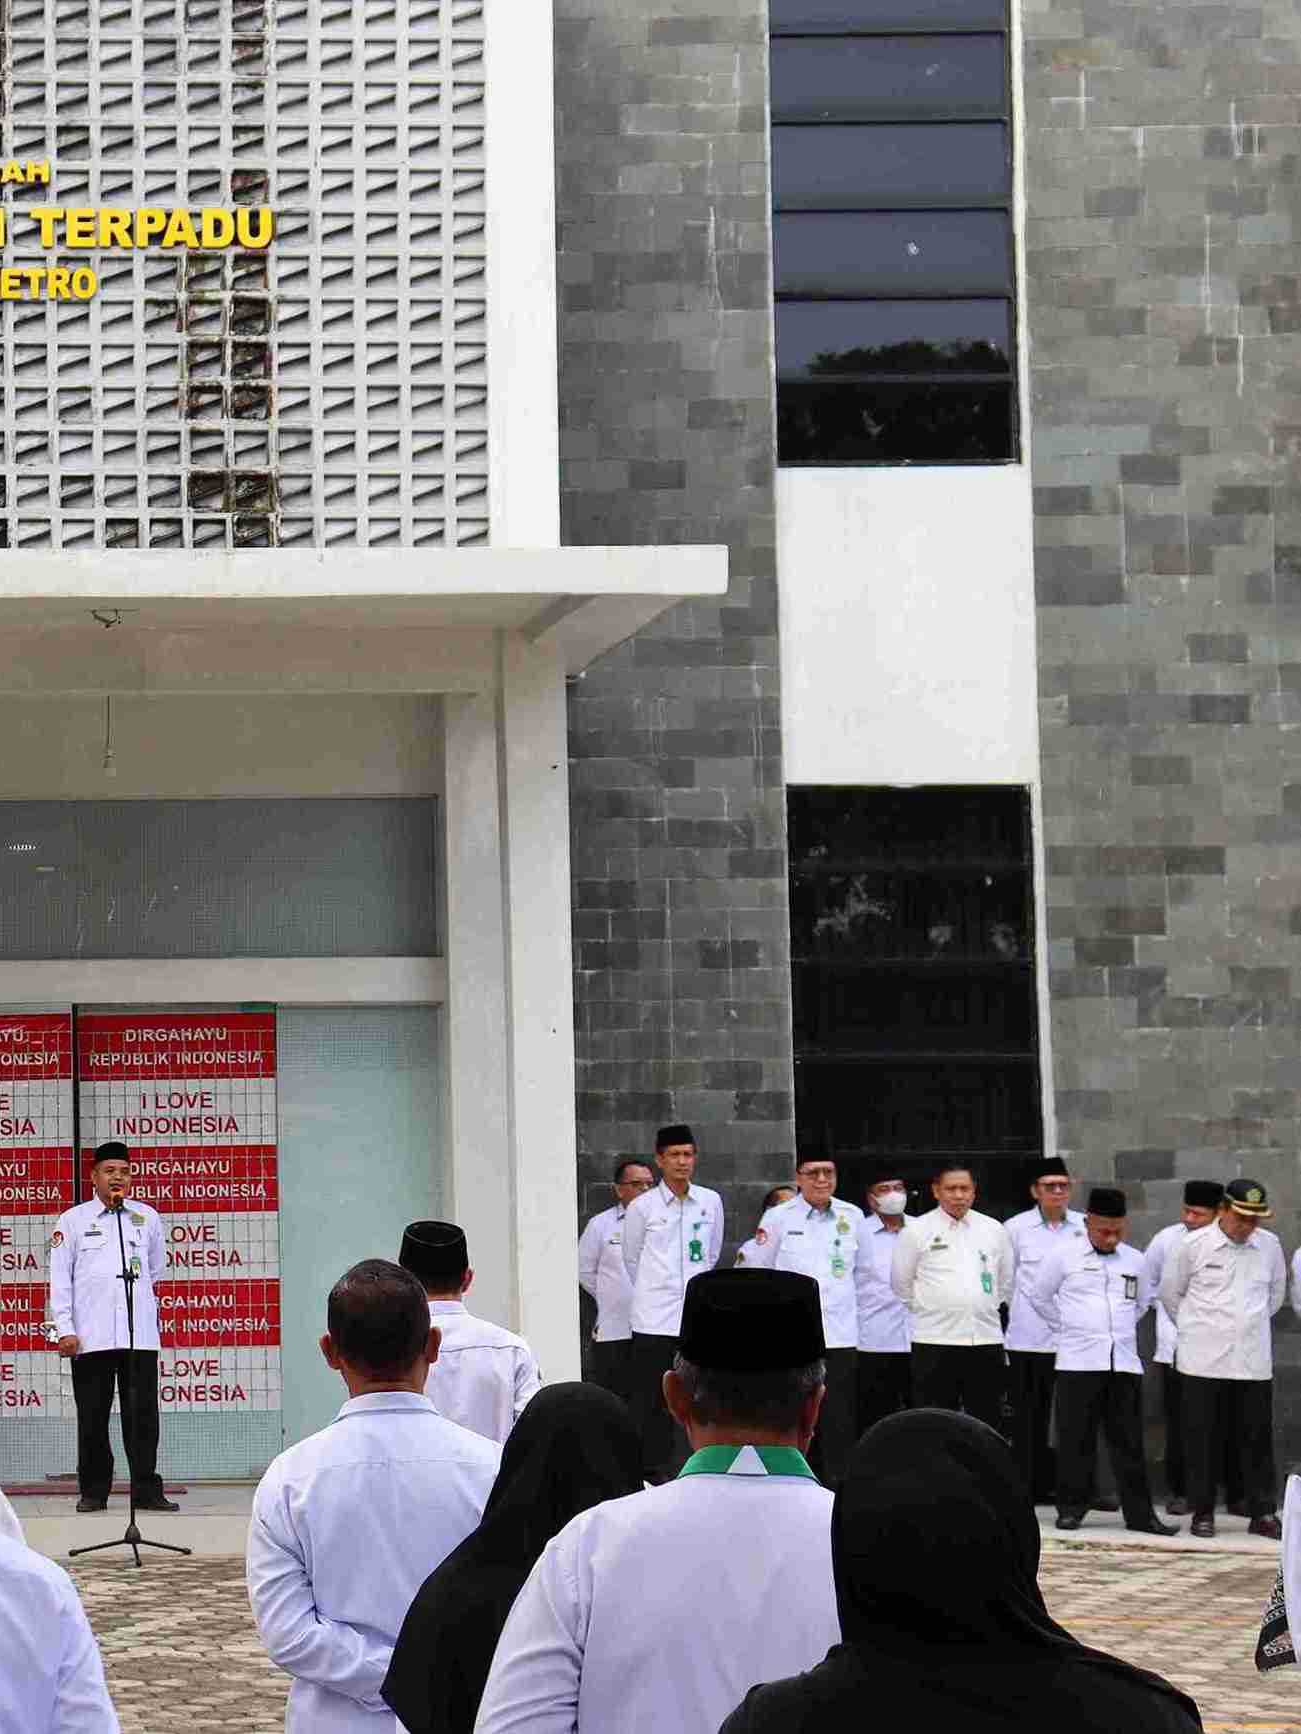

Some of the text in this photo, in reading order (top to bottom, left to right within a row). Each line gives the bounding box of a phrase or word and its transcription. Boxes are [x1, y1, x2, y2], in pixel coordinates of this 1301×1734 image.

[29, 207, 275, 250] TERPADU
[125, 1028, 227, 1042] DIRGAHAYU
[89, 1050, 263, 1067] REPUBLIK INDONESIA
[141, 1091, 213, 1109] I LOVE
[116, 1116, 239, 1135] INDONESIA
[131, 1160, 230, 1175] DIRGAHAYU
[180, 1183, 267, 1198] INDONESIA
[165, 1225, 216, 1243] OVE
[183, 1317, 270, 1333] INDONESIA
[160, 1359, 219, 1377] LOVE
